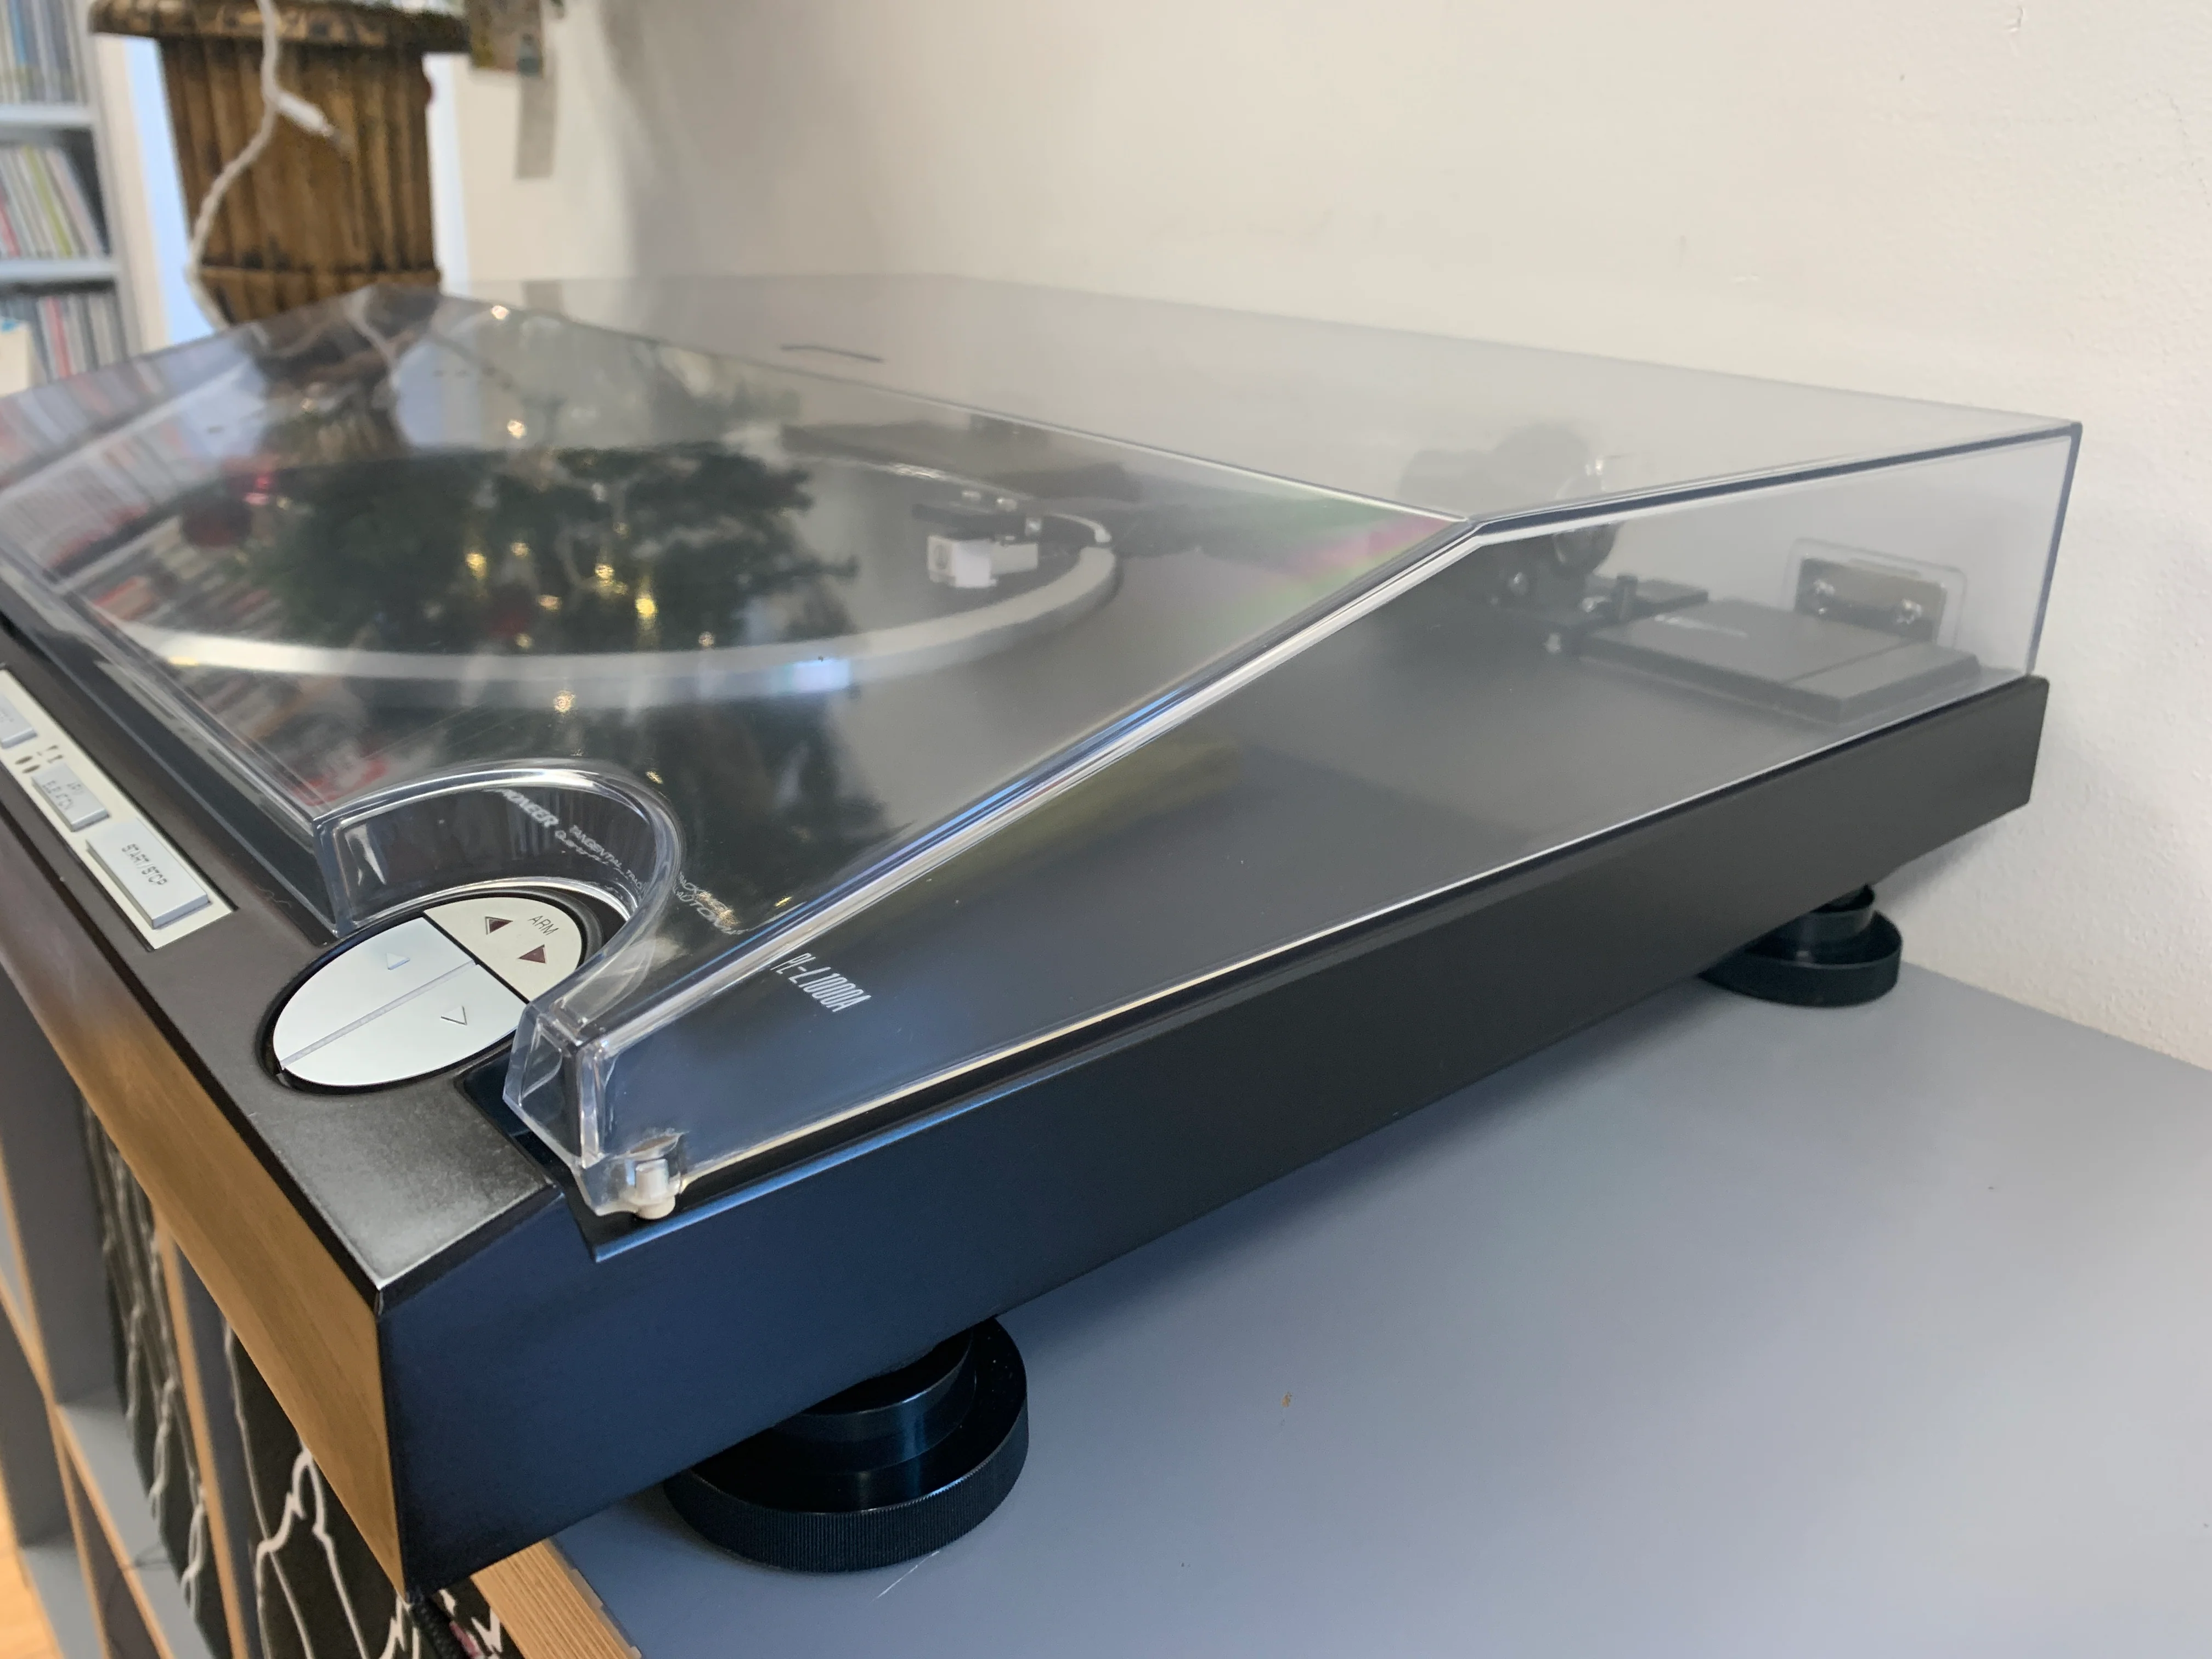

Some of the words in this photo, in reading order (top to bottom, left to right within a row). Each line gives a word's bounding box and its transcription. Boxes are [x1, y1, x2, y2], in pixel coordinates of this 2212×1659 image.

[122, 844, 167, 885] START/STOP
[527, 916, 559, 936] ARM
[770, 952, 872, 1012] PL-L1000A
